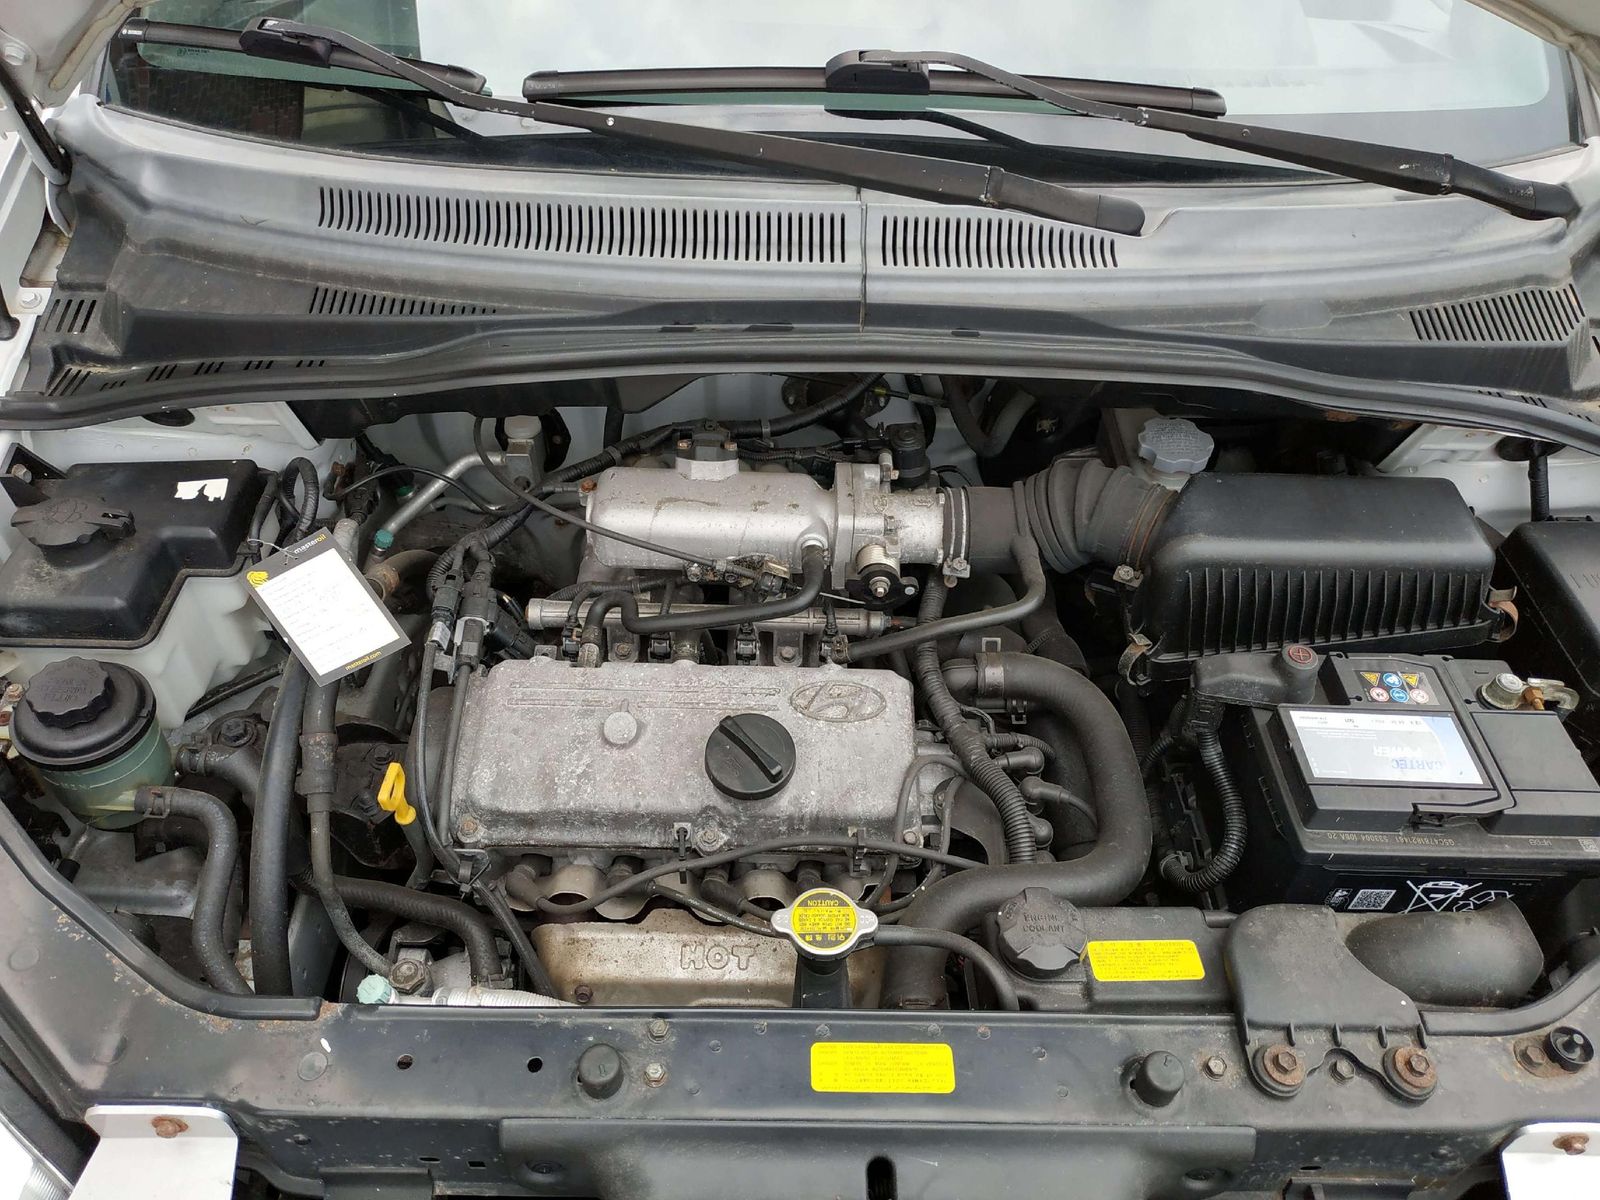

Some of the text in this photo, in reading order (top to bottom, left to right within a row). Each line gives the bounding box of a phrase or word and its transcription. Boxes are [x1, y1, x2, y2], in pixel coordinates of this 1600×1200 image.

[294, 533, 327, 555] masteroil
[345, 650, 382, 671] masteroil.com
[1391, 757, 1445, 771] CARTEC
[1022, 925, 1066, 933] COOLANT
[680, 944, 755, 971] HOT
